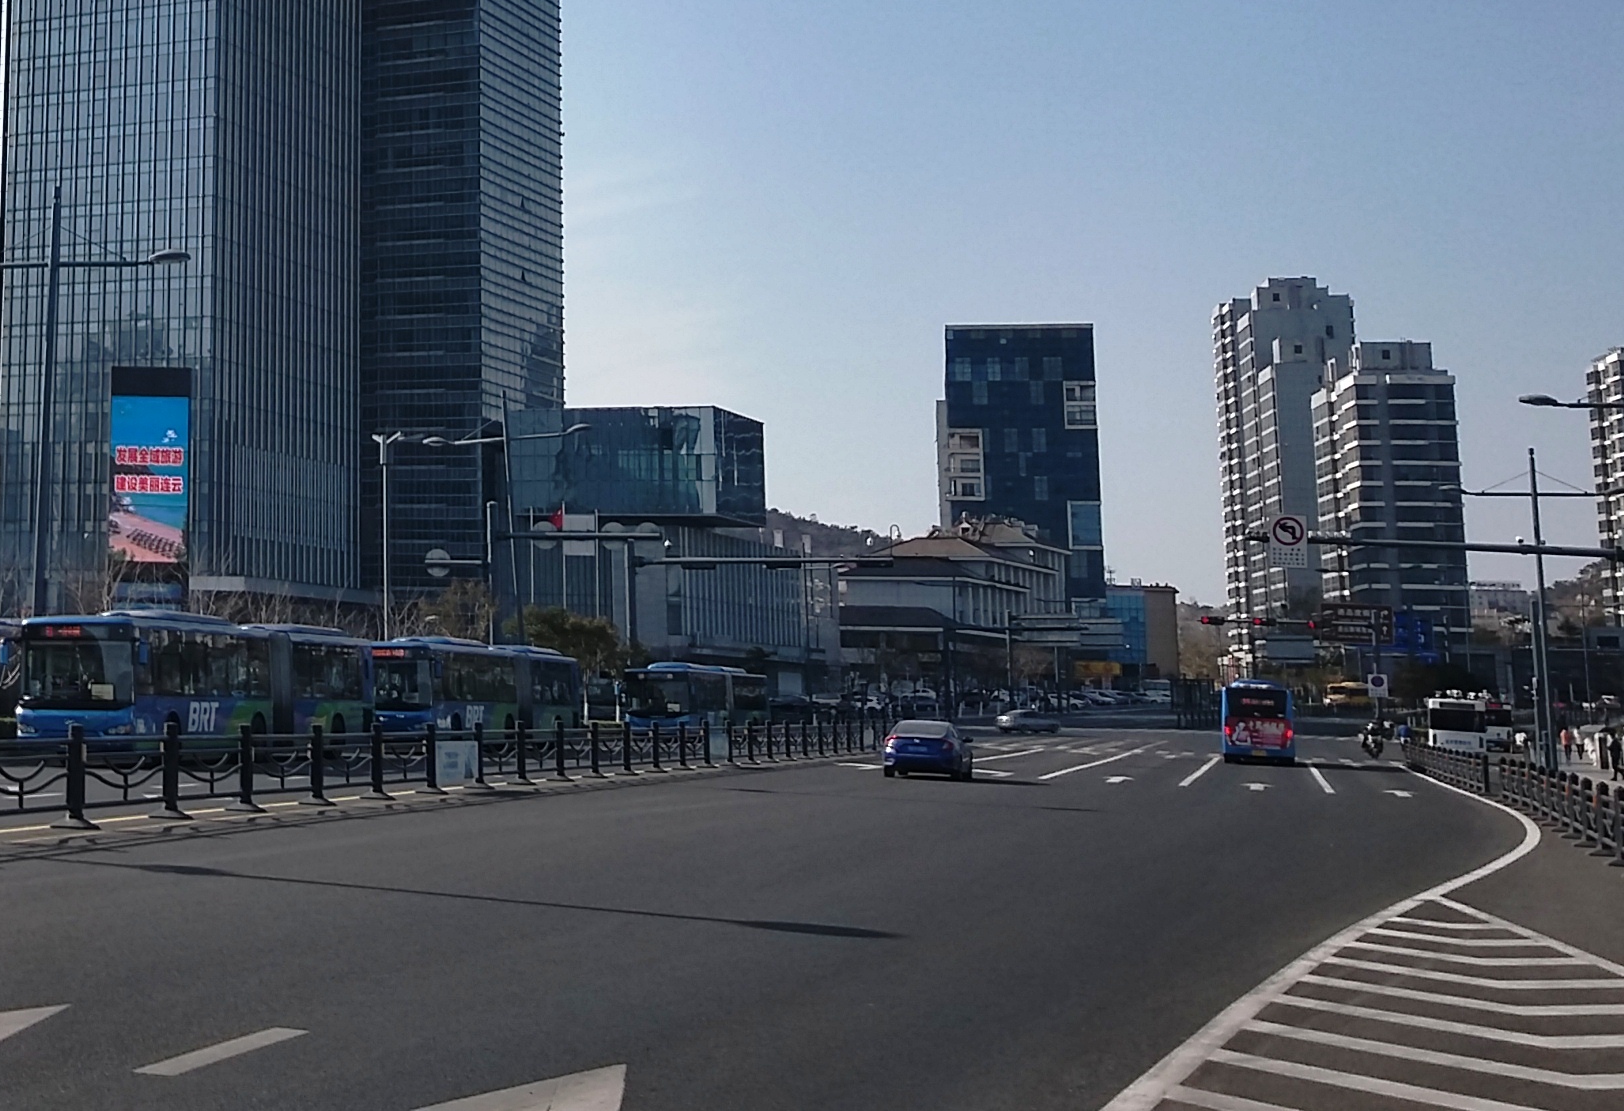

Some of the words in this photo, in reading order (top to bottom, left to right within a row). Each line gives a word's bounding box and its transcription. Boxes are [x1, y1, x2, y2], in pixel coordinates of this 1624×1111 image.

[115, 445, 184, 466] 发展全域旅游
[115, 475, 183, 494] 建设美丽连云
[187, 701, 220, 733] BRT
